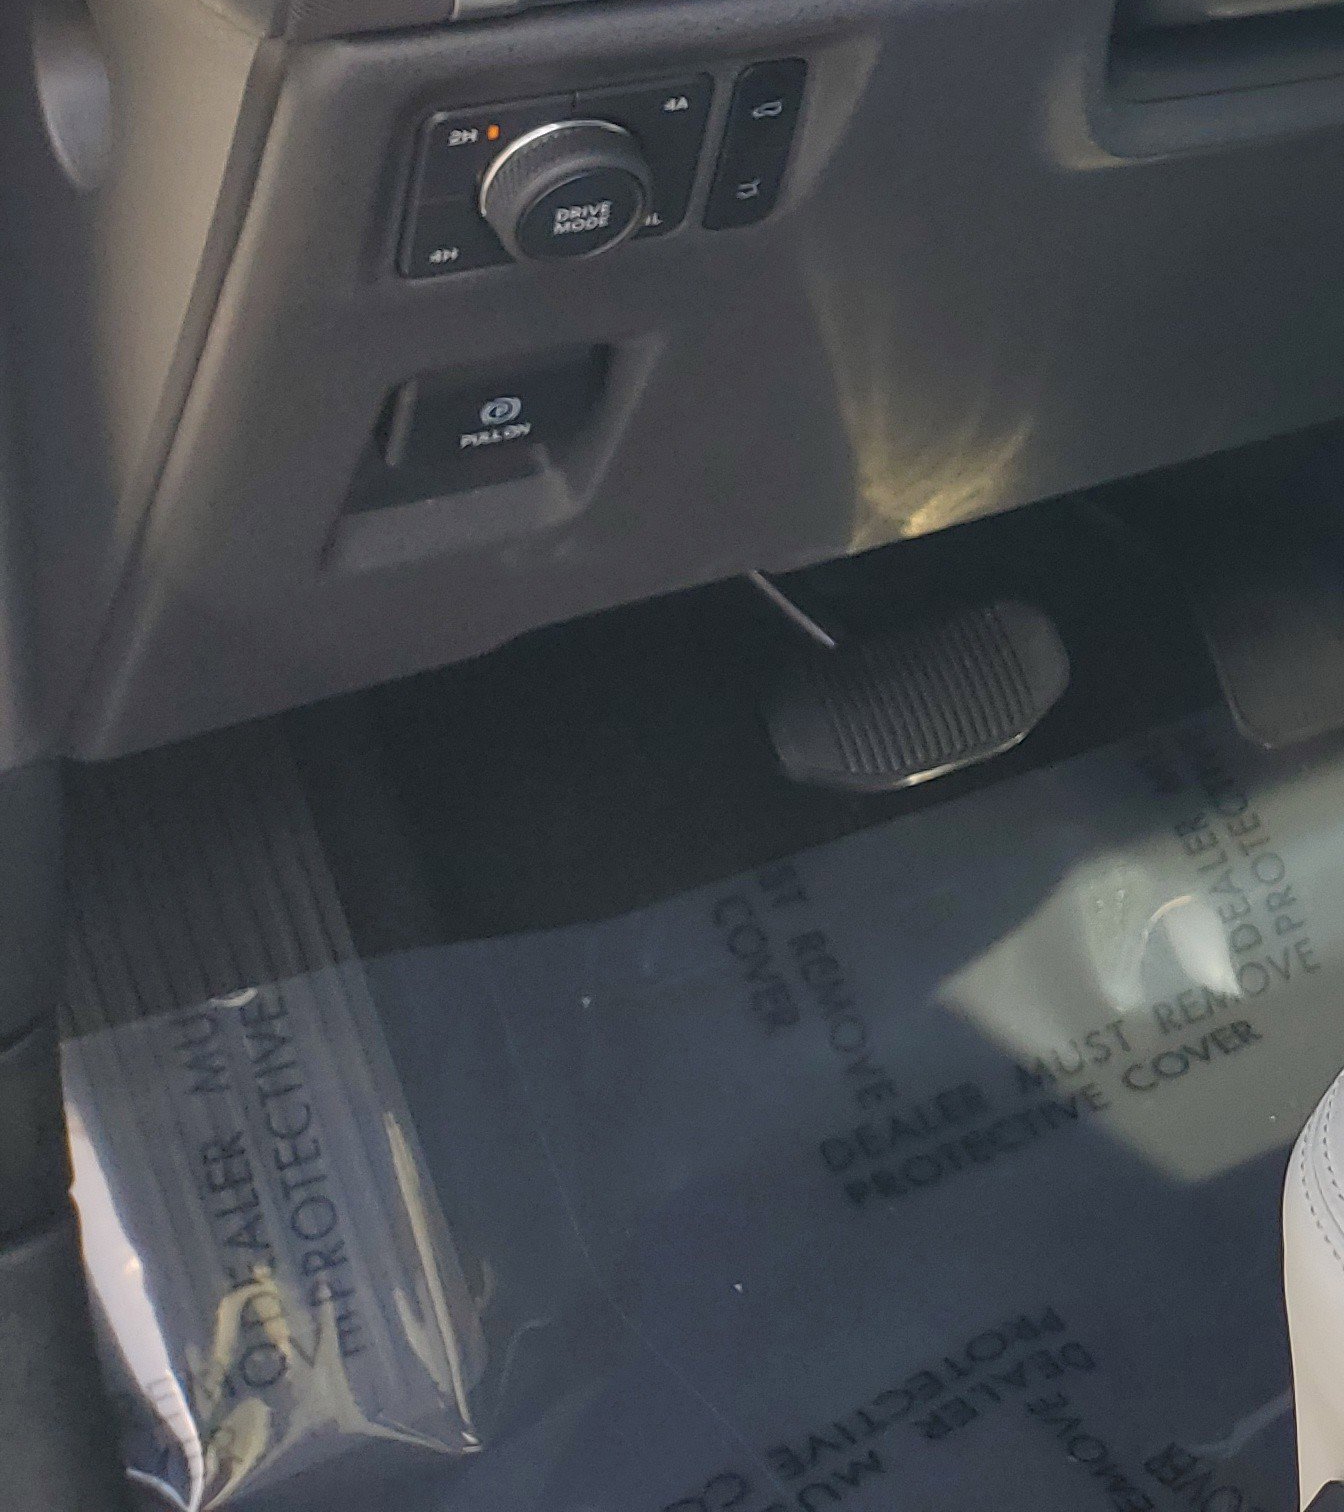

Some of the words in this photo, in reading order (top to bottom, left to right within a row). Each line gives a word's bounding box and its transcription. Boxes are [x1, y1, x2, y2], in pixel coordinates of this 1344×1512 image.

[664, 96, 689, 112] 4A
[448, 128, 478, 147] 2H
[552, 215, 609, 236] MODE
[554, 199, 613, 224] DRIVE
[428, 246, 460, 264] 4H
[504, 421, 532, 441] ON
[1174, 813, 1263, 955] DEALER
[818, 1081, 987, 1174] DEALER
[1013, 1018, 1137, 1093] MUST
[1151, 936, 1324, 1038] REMOVE
[843, 1080, 1113, 1210] PROTECTIVE
[1120, 1018, 1263, 1094] COVER
[240, 993, 346, 1310] PROTECTIVE
[765, 1306, 1067, 1483] PROTECTIVE
[914, 1342, 1096, 1441] DEALER
